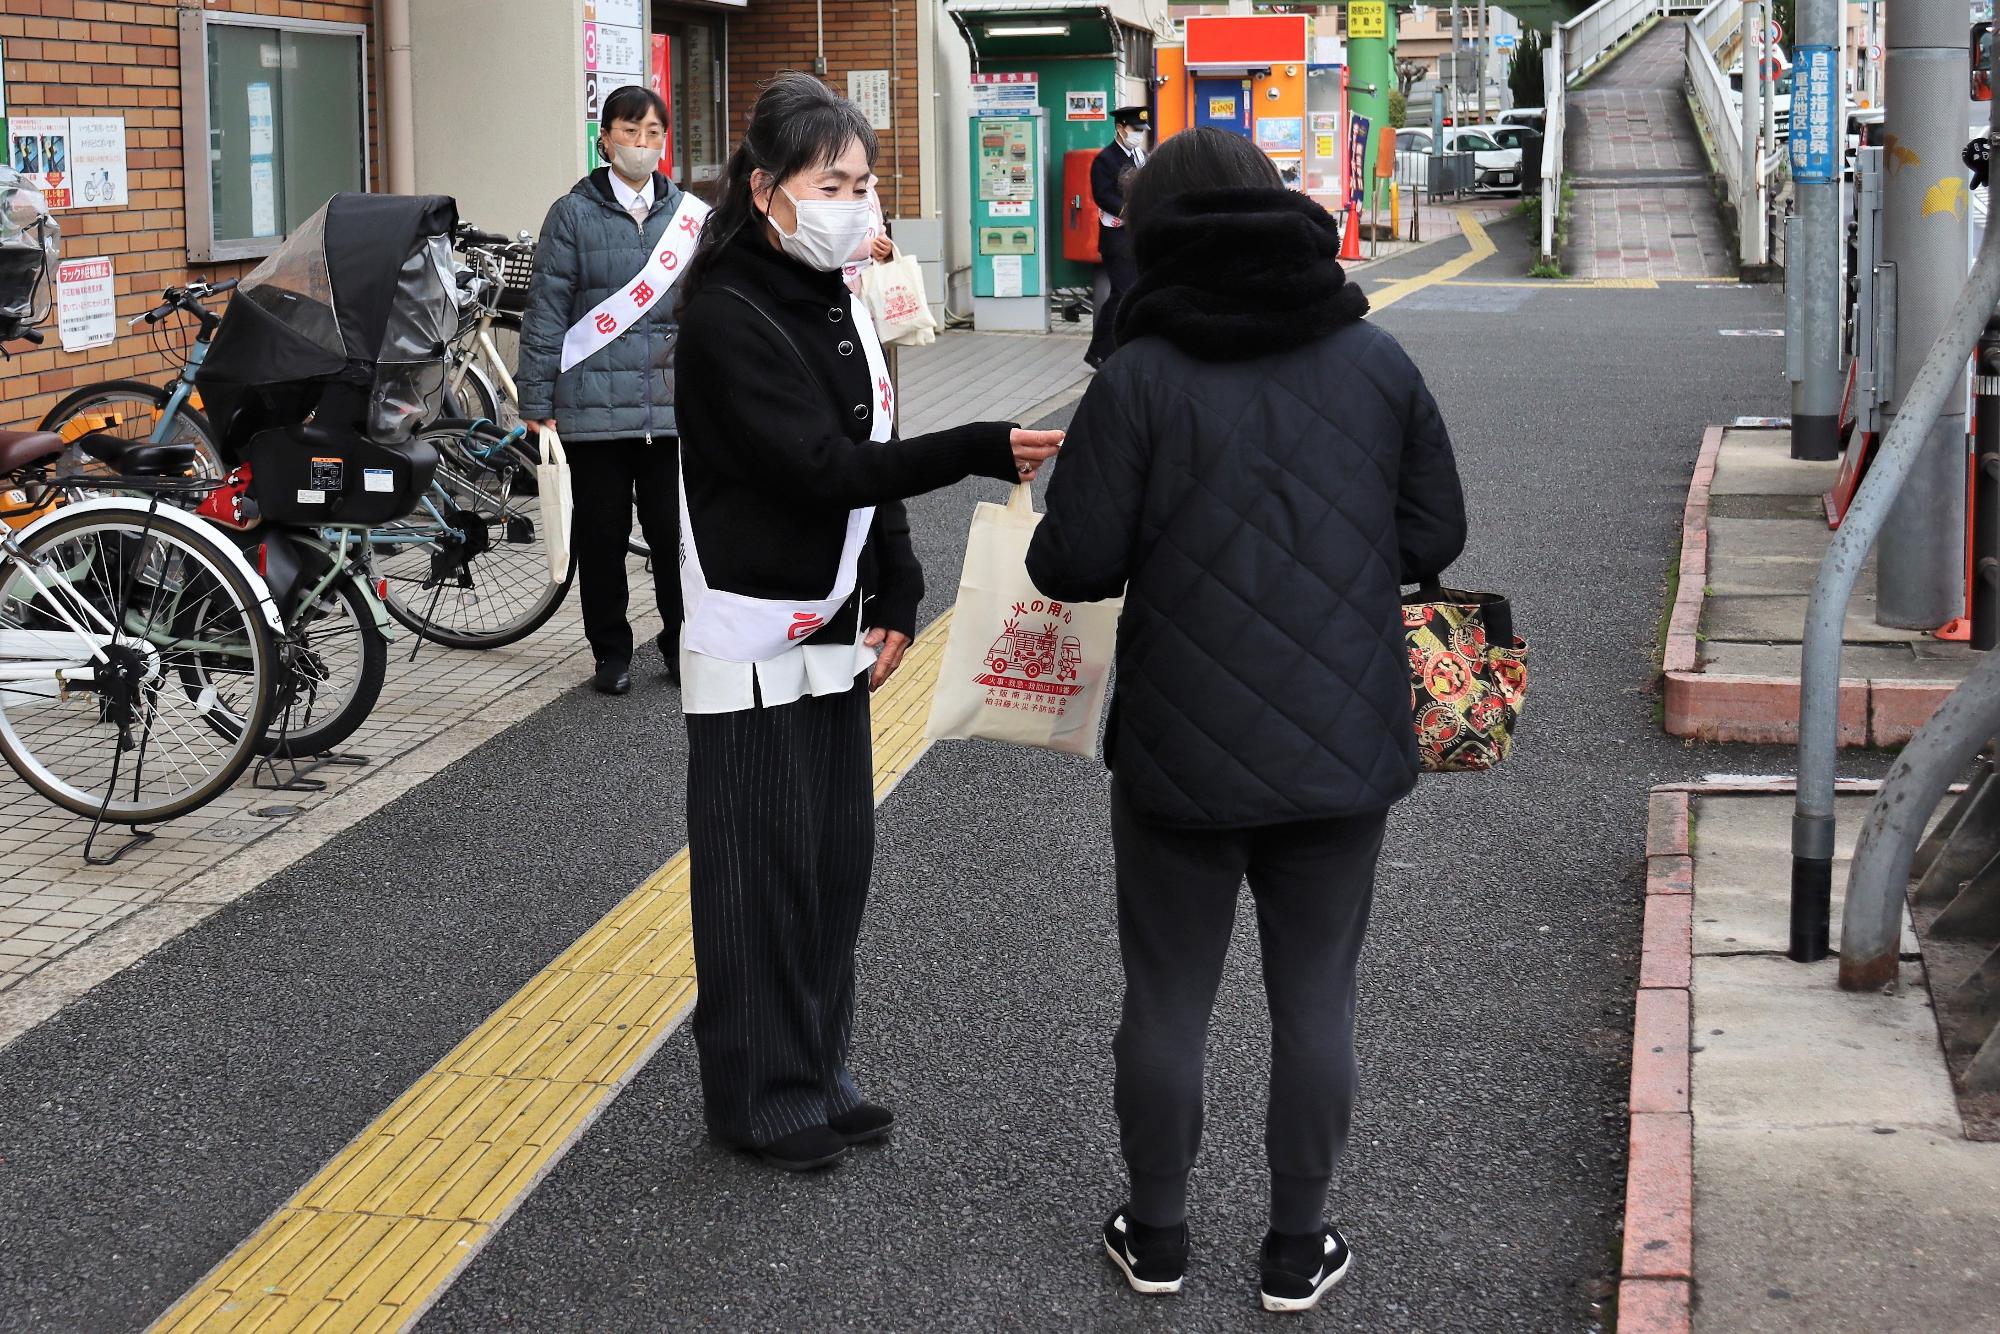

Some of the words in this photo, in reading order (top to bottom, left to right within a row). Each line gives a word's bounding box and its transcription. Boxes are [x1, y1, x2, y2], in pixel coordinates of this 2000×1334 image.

[586, 30, 596, 64] 3
[587, 79, 597, 113] 2
[1792, 71, 1809, 168] 重点地区・路線
[1810, 53, 1829, 155] 自転車指導啓発
[595, 214, 701, 335] 火の用心
[1011, 600, 1072, 625] 火の用心
